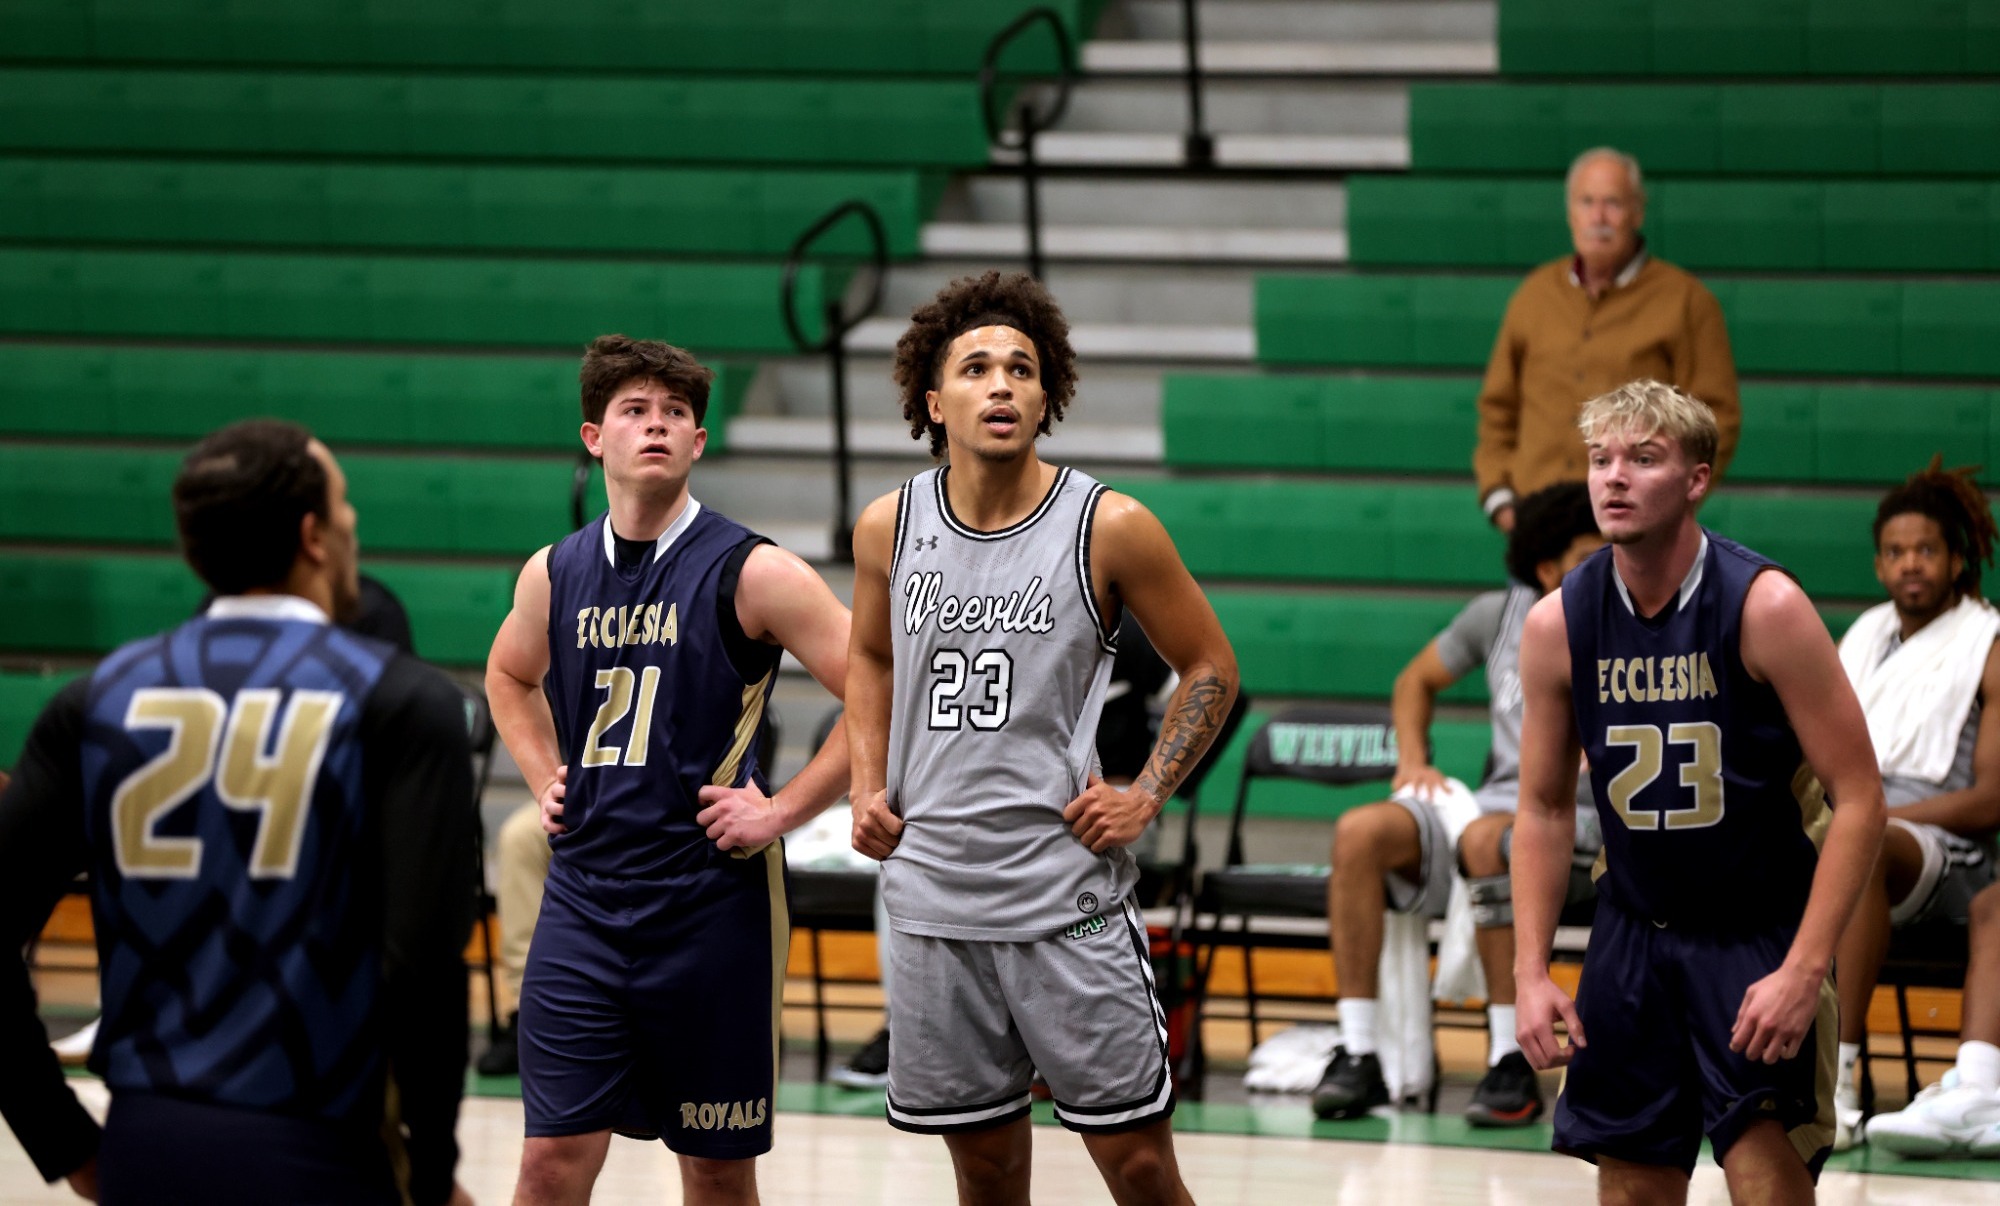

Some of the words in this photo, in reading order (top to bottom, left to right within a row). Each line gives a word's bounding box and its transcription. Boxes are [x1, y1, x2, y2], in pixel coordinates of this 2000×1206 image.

[577, 601, 678, 649] ECCLESIA
[904, 571, 1054, 635] Weevils
[928, 647, 1014, 731] 23
[1597, 652, 1718, 703] ECCLESIA
[581, 666, 661, 768] 21
[110, 687, 344, 879] 24
[1605, 721, 1725, 830] 23
[679, 1097, 767, 1130] ROYALS
